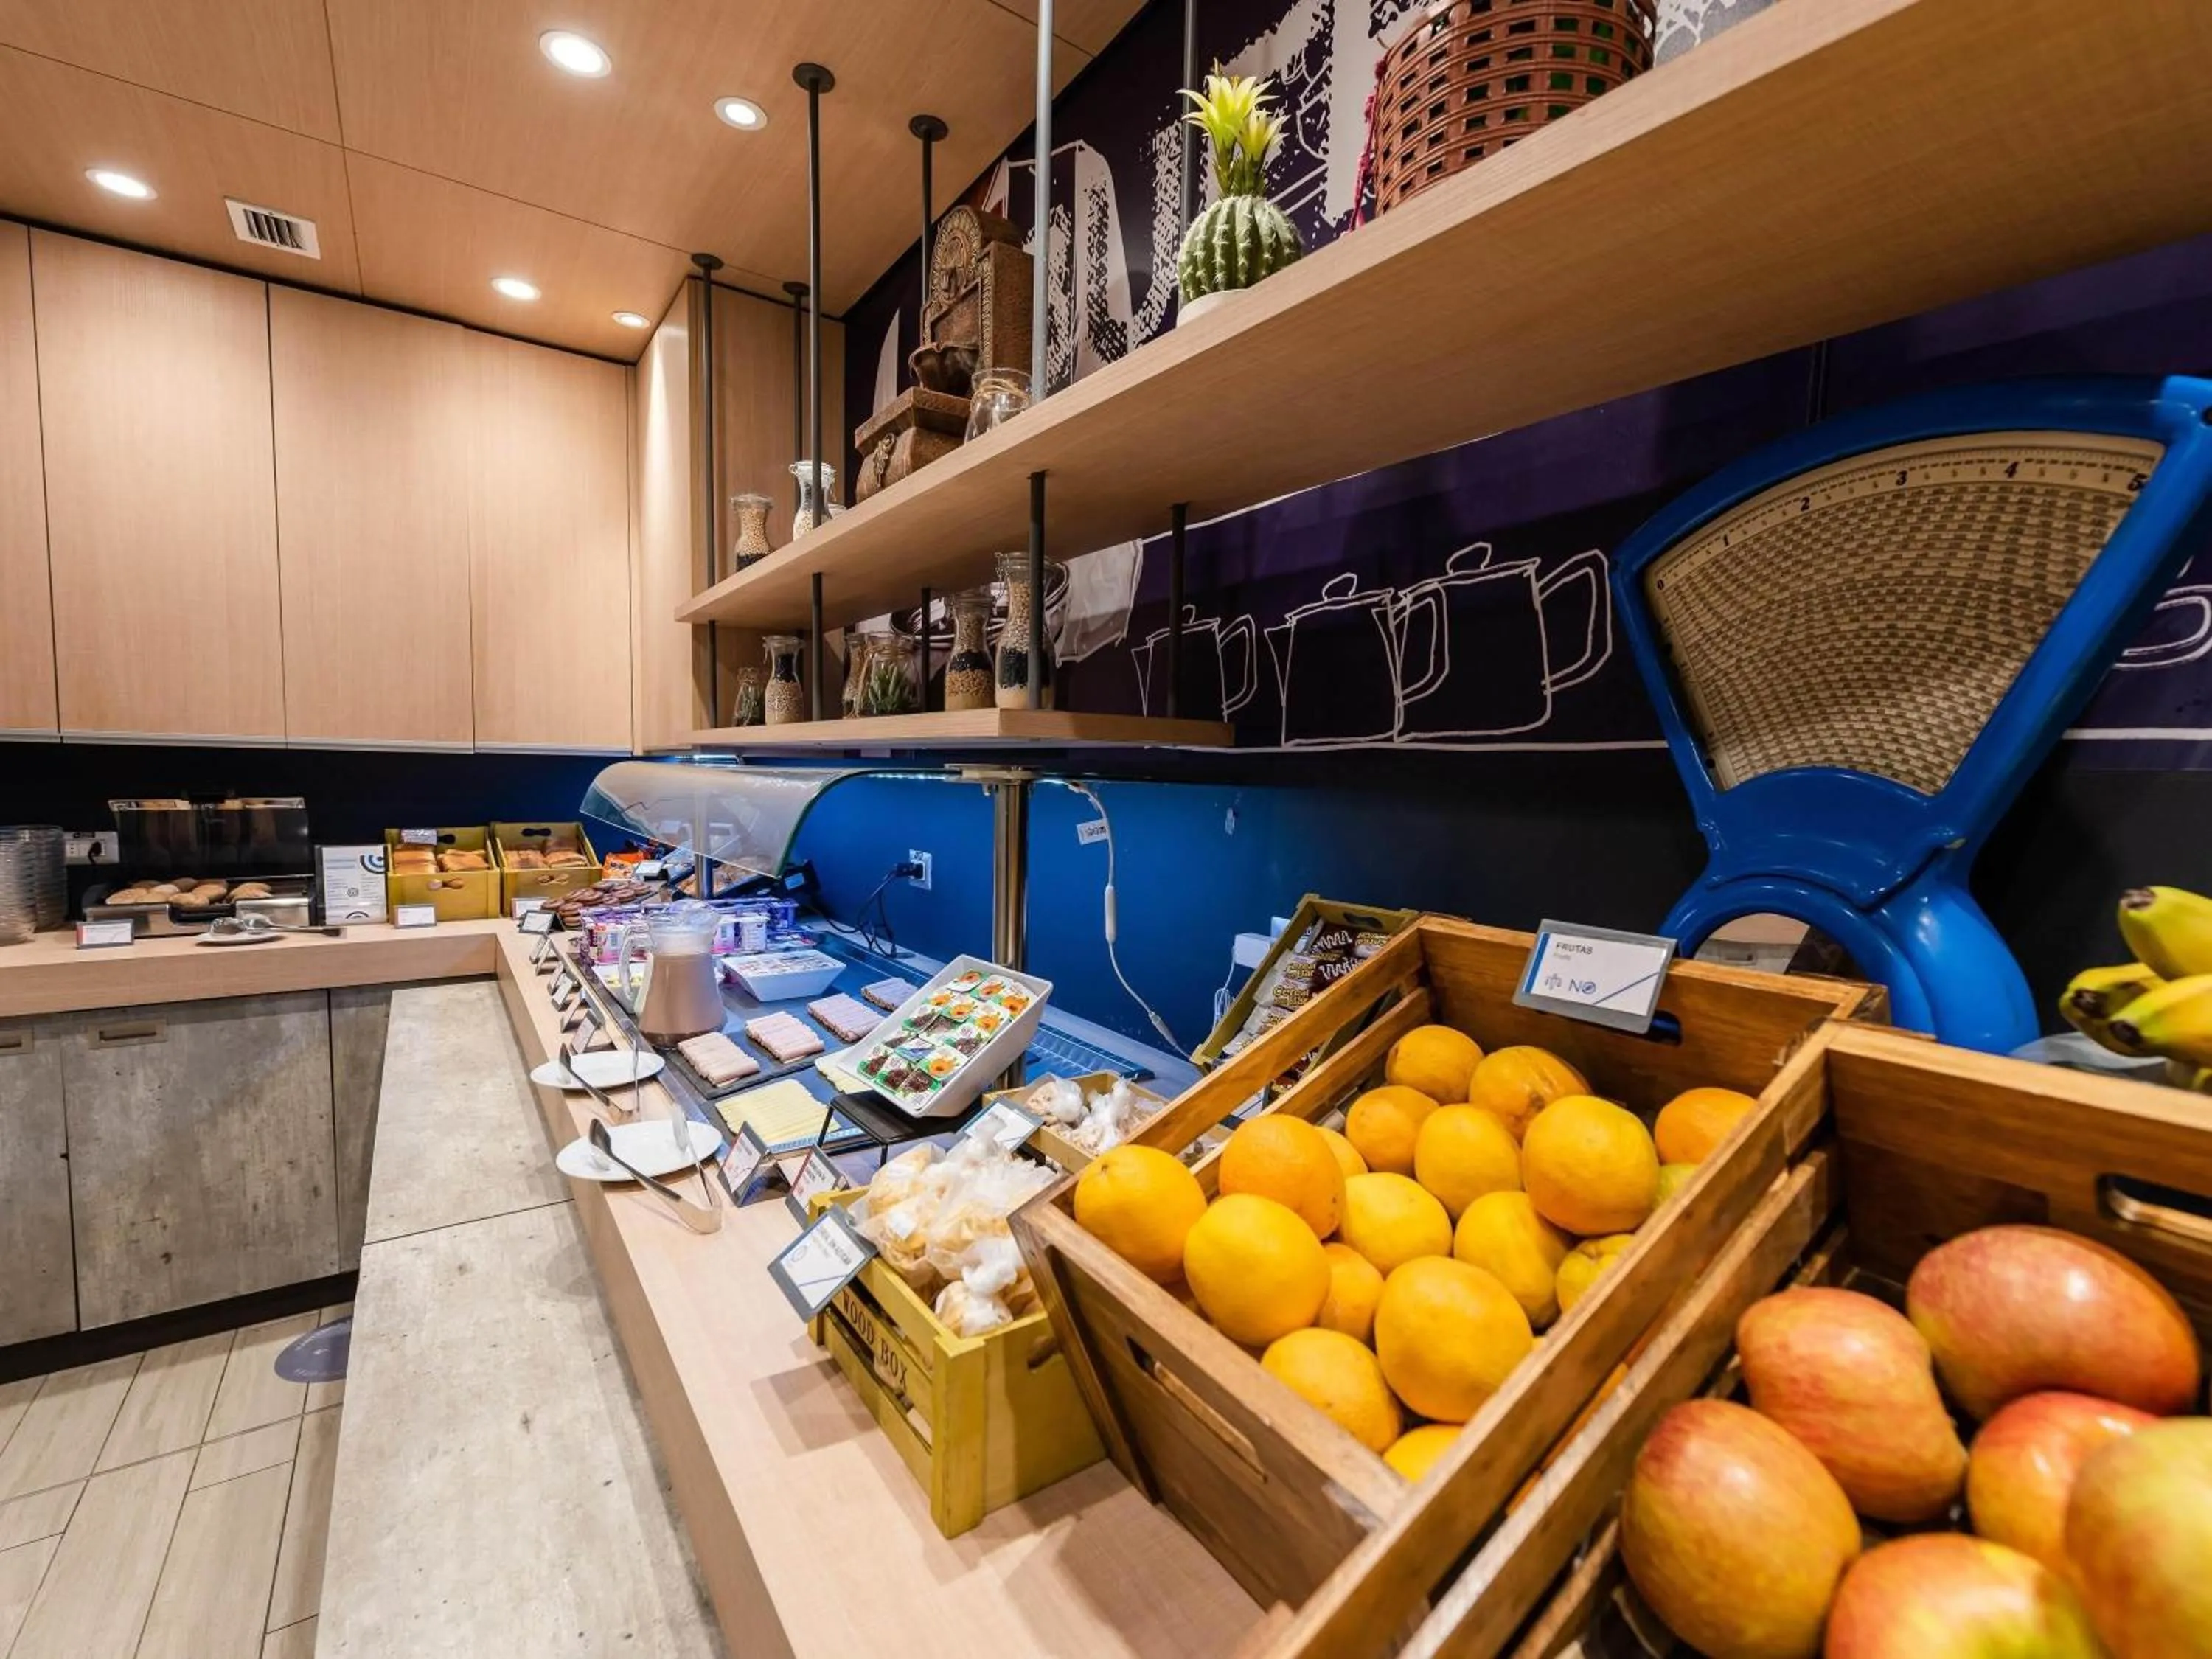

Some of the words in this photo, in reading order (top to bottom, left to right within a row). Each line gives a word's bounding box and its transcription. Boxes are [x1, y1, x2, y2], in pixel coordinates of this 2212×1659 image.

[1801, 496, 1811, 512] 2
[1896, 470, 1908, 486] 3
[2004, 461, 2020, 479] 4
[1556, 942, 1593, 956] FRUTAS
[880, 1337, 908, 1391] BOX
